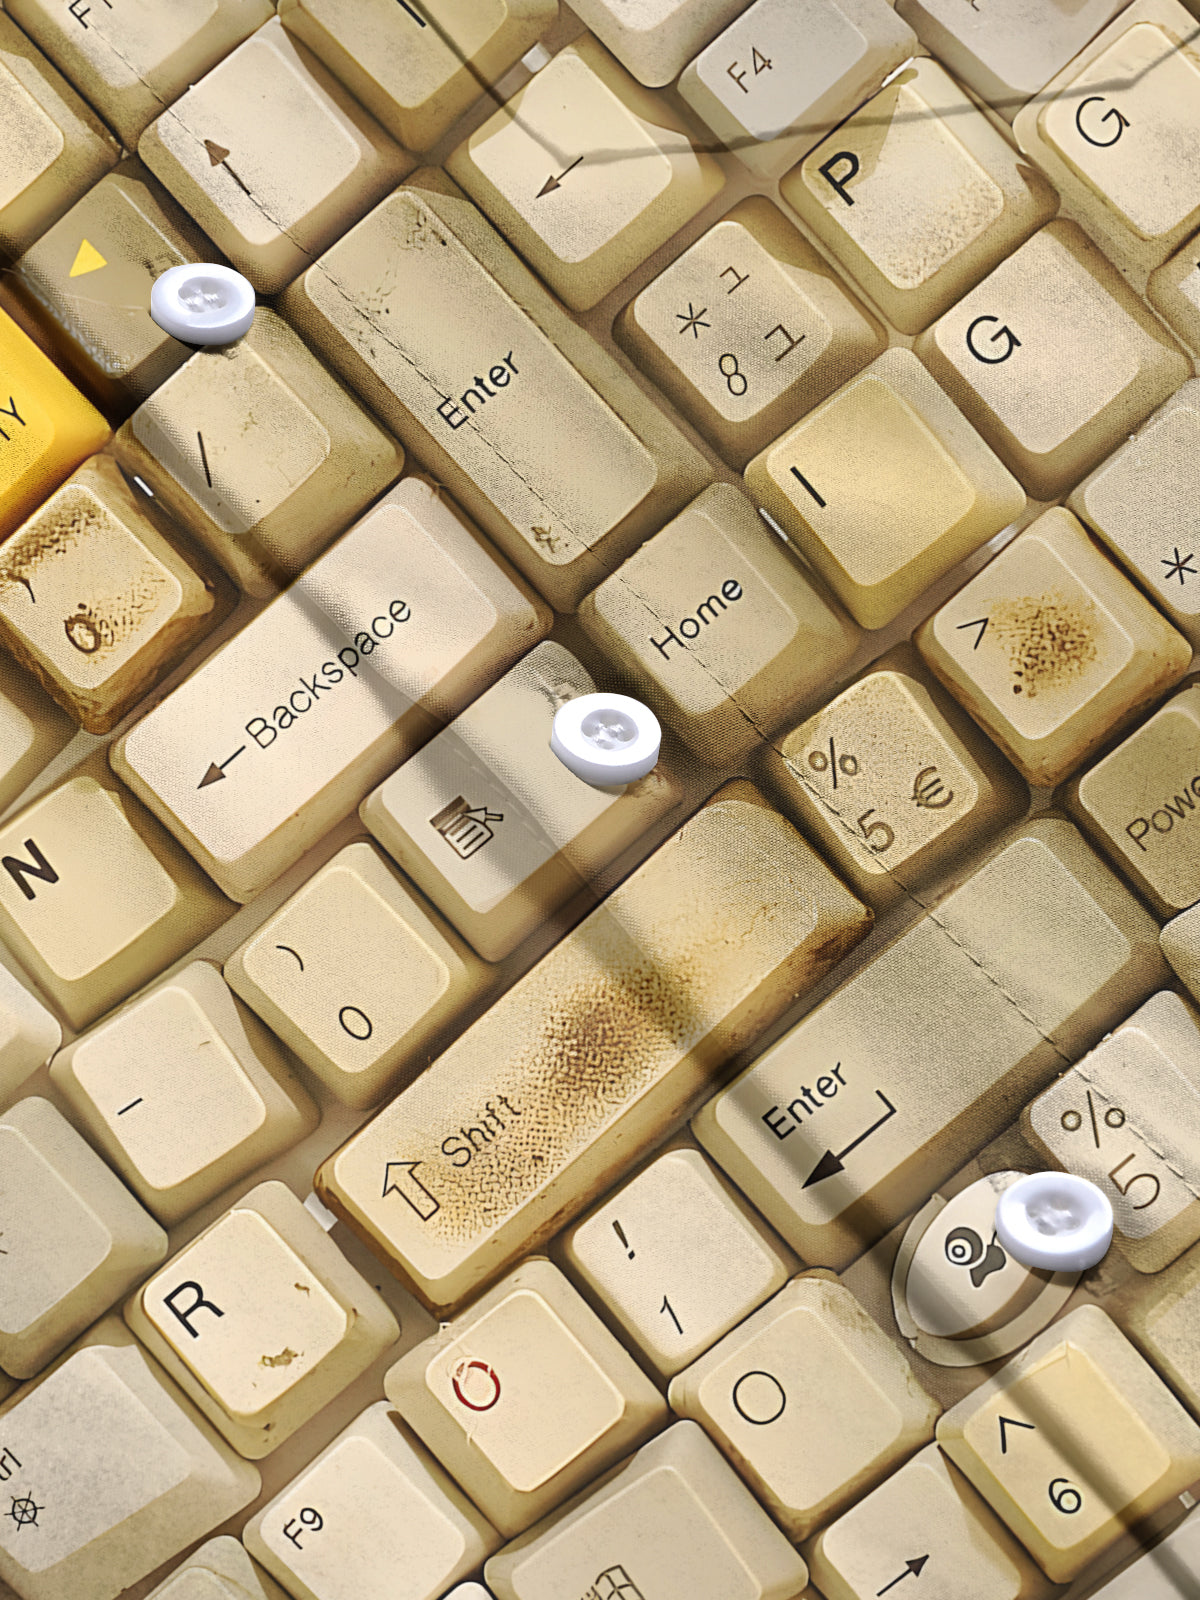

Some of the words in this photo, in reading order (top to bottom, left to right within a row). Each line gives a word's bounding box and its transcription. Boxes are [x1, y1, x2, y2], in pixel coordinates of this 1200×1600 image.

[727, 46, 773, 94] F4
[1075, 96, 1131, 148] G
[818, 151, 860, 206] P
[965, 315, 1022, 365] G
[436, 350, 519, 430] Enter
[718, 353, 748, 396] 8
[649, 577, 743, 661] Home
[245, 598, 412, 751] Backspace
[808, 737, 859, 790] %
[857, 808, 895, 853] 5
[911, 765, 954, 810] €
[1, 838, 60, 901] N
[761, 1061, 848, 1141] Enter
[1060, 1089, 1126, 1150] %
[441, 1094, 522, 1167] Shift
[1108, 1153, 1161, 1210] 5
[611, 1219, 637, 1260] !
[163, 1280, 225, 1339] R
[659, 1294, 684, 1335] 1
[452, 1361, 501, 1412] O
[732, 1370, 786, 1425] O
[0, 1447, 22, 1481] rl
[1047, 1477, 1083, 1514] 6
[282, 1506, 325, 1550] F9
